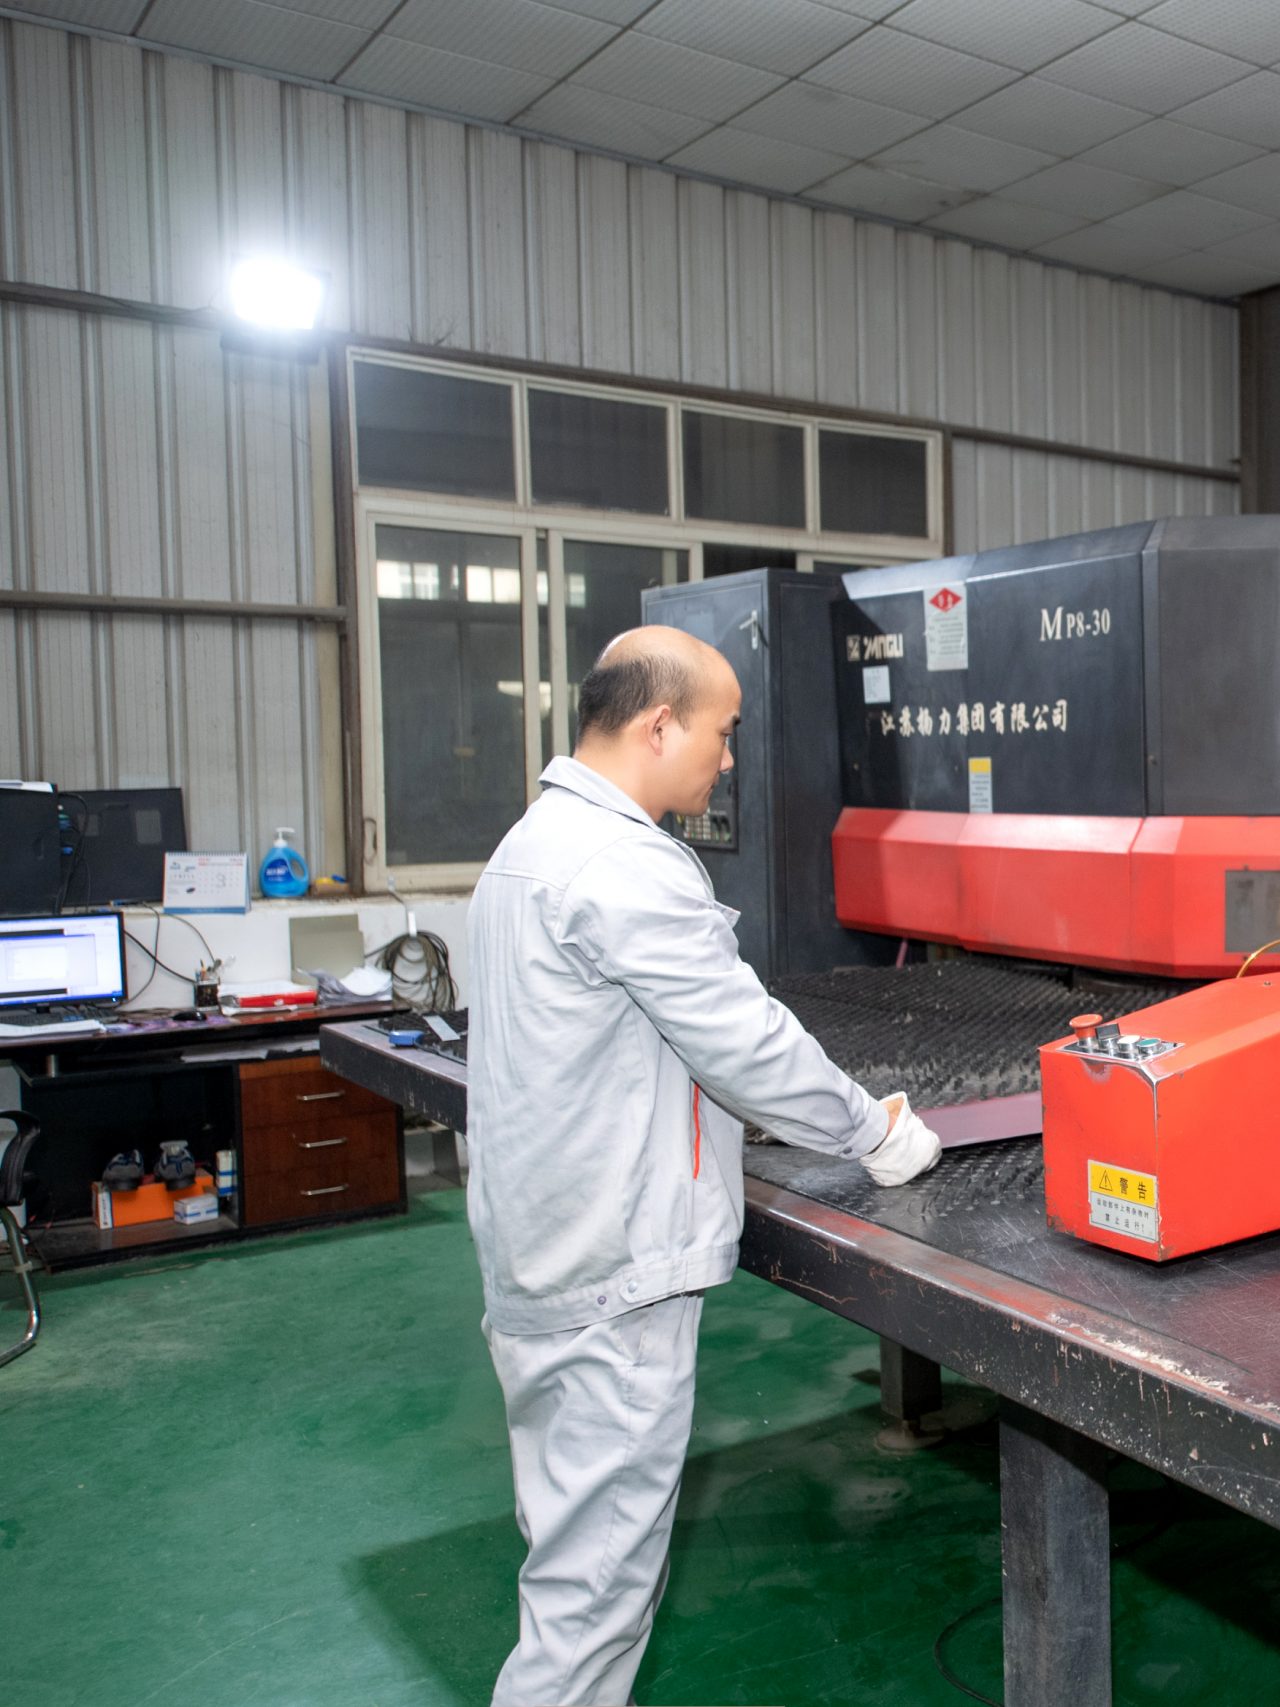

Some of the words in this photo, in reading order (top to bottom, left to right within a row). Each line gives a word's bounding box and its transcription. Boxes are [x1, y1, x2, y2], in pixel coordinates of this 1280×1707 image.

[1040, 606, 1110, 641] MP8-30
[880, 699, 1068, 737] 江苏扬力集团有限公司
